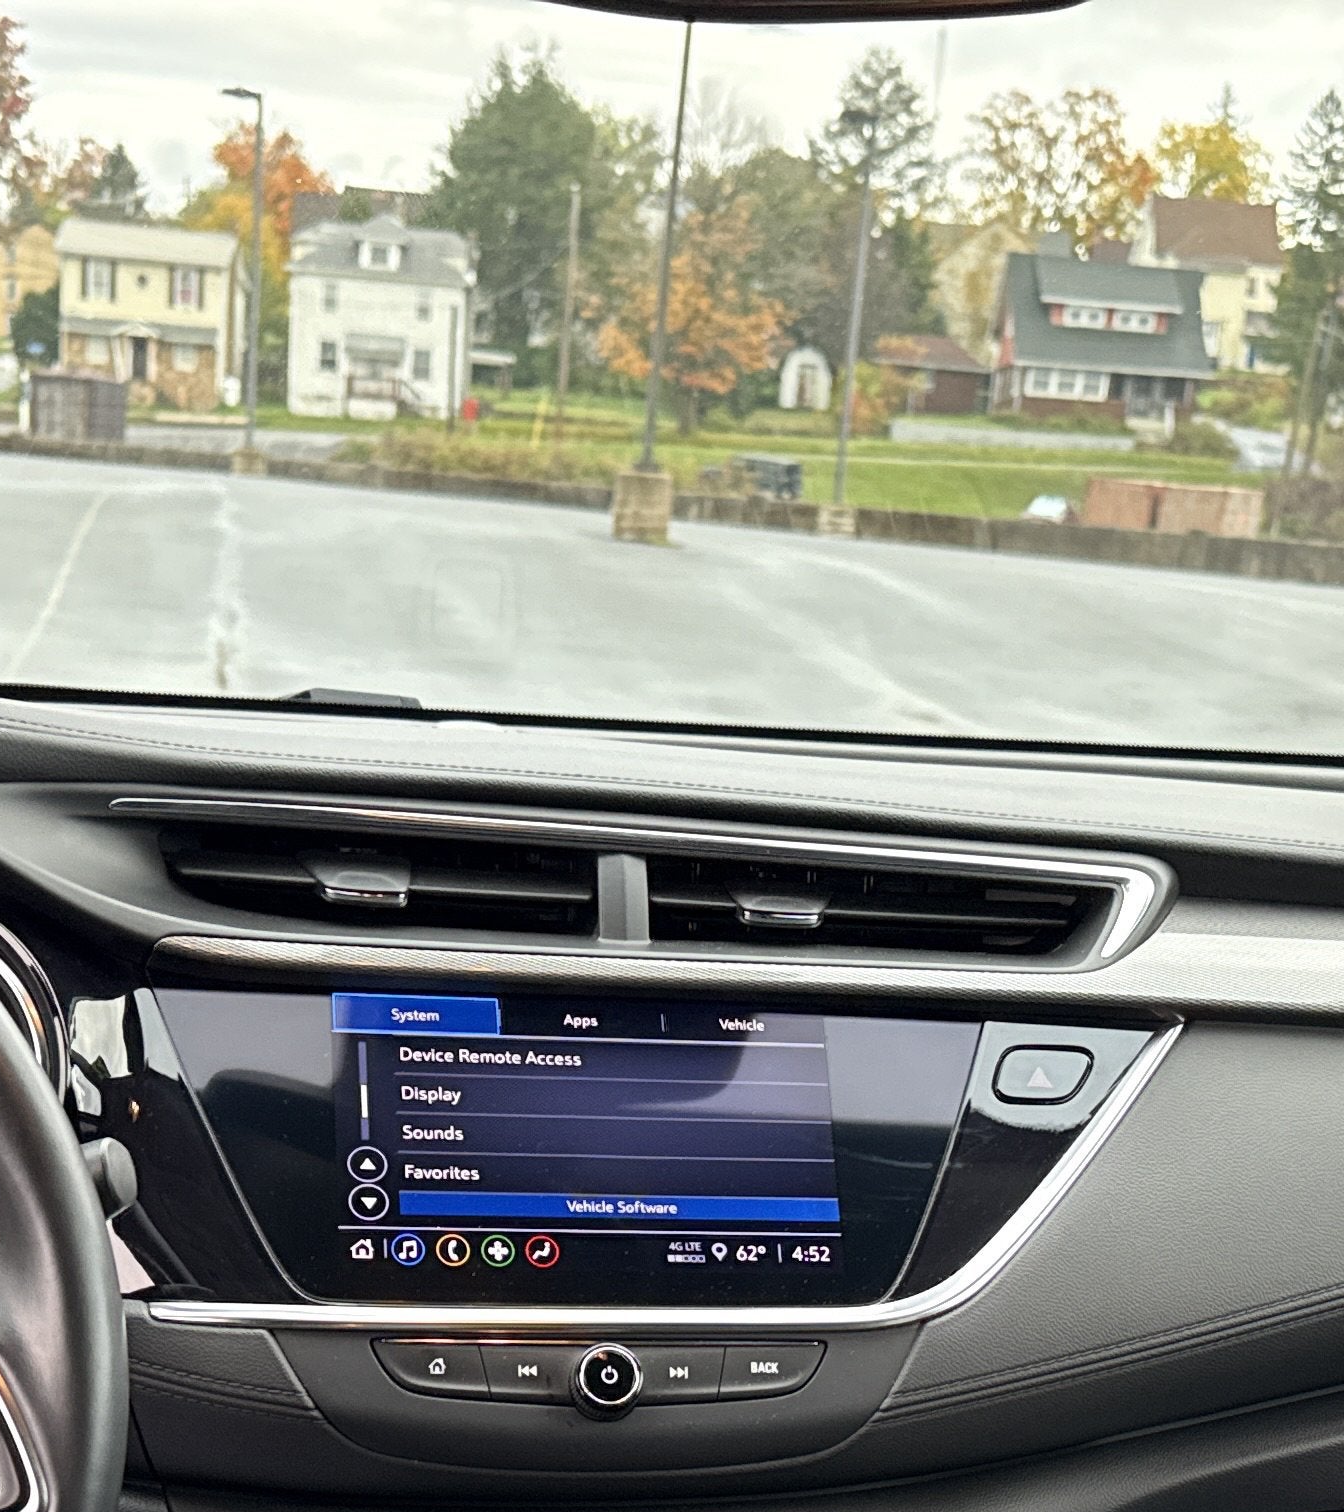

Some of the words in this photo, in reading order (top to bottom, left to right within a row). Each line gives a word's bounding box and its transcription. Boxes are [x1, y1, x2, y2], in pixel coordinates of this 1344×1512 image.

[391, 1008, 440, 1025] System
[563, 1013, 598, 1030] Apps
[718, 1017, 765, 1032] Vehicle
[400, 1047, 454, 1064] Device
[460, 1048, 522, 1065] Remote
[525, 1050, 582, 1067] Access
[401, 1086, 461, 1105] Display
[402, 1124, 464, 1142] Sounds
[404, 1164, 480, 1182] Favorites
[566, 1199, 614, 1215] Vehicle
[618, 1200, 678, 1216] Software
[668, 1241, 681, 1252] 4G
[683, 1241, 702, 1252] LTE
[791, 1245, 830, 1263] 4:52
[750, 1360, 778, 1375] BACK
